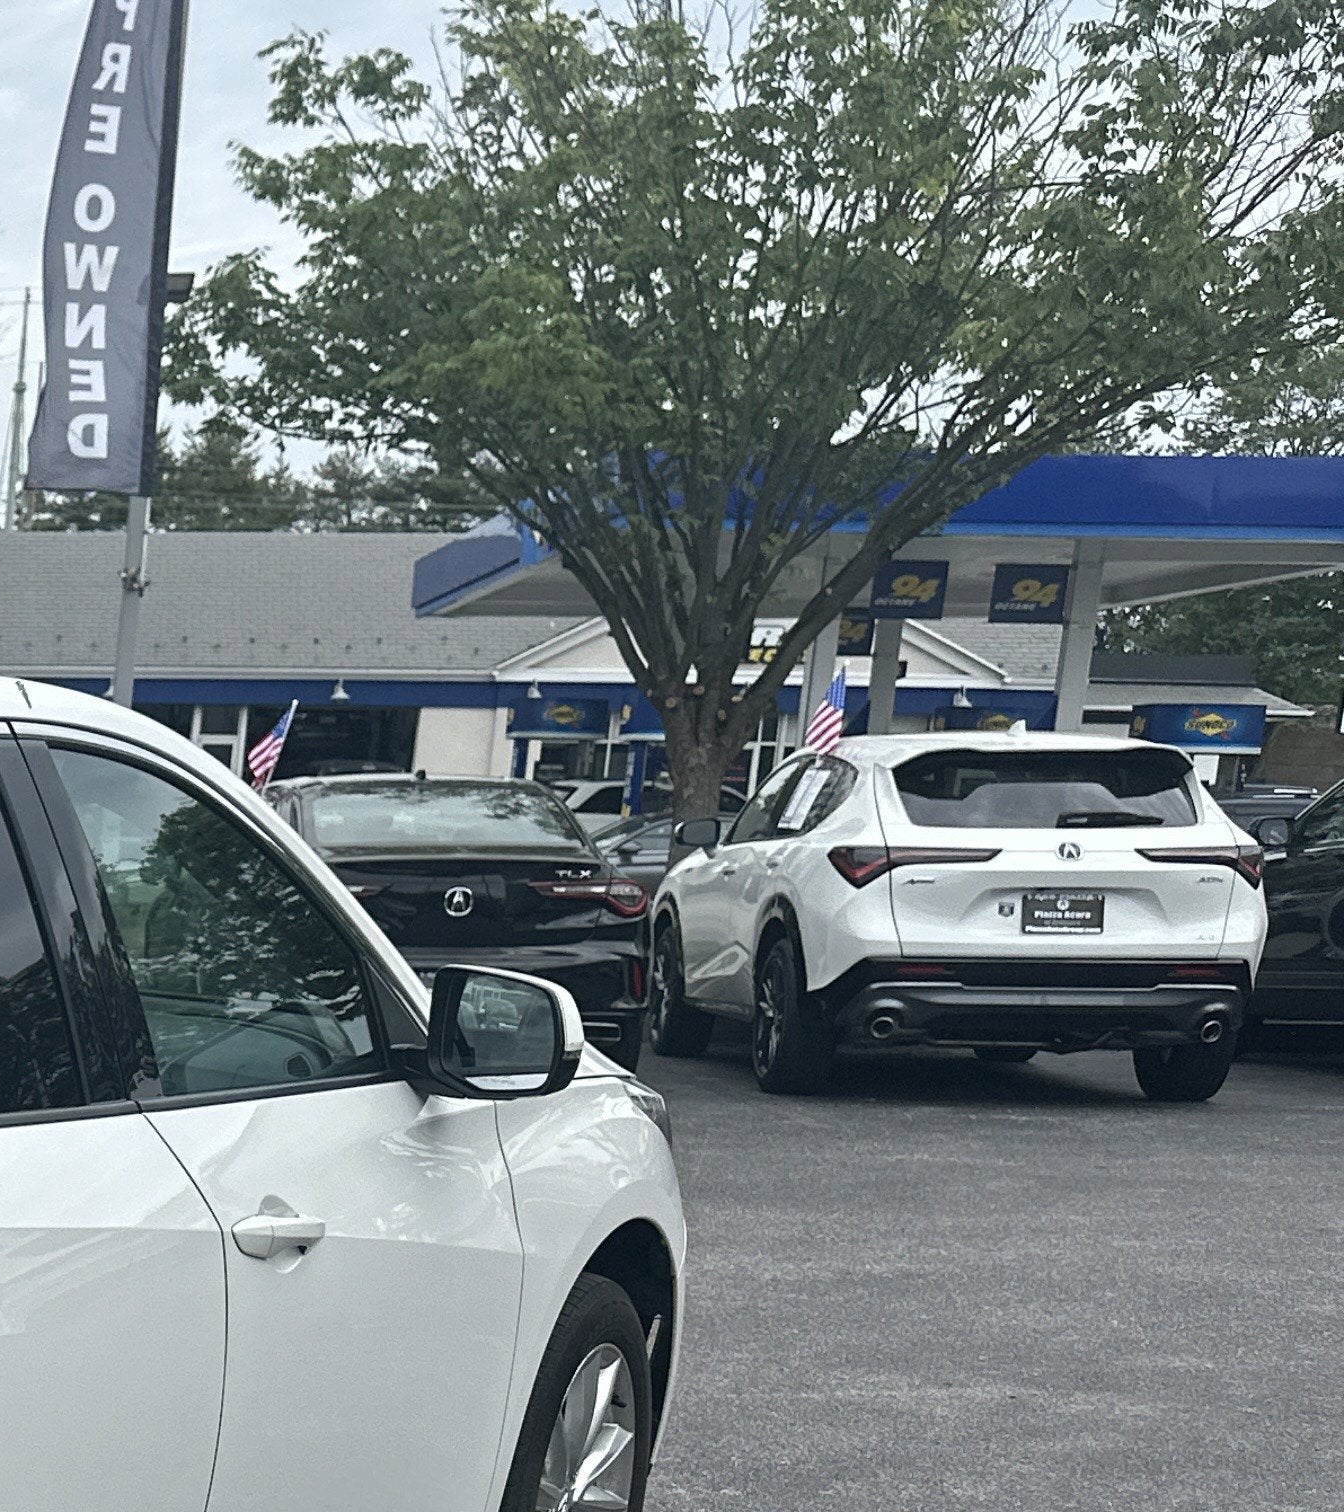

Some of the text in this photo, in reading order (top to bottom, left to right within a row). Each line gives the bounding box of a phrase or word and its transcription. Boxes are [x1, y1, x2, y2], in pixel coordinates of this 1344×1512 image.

[890, 574, 941, 603] 94
[1012, 578, 1060, 608] 94
[554, 869, 592, 879] TLX
